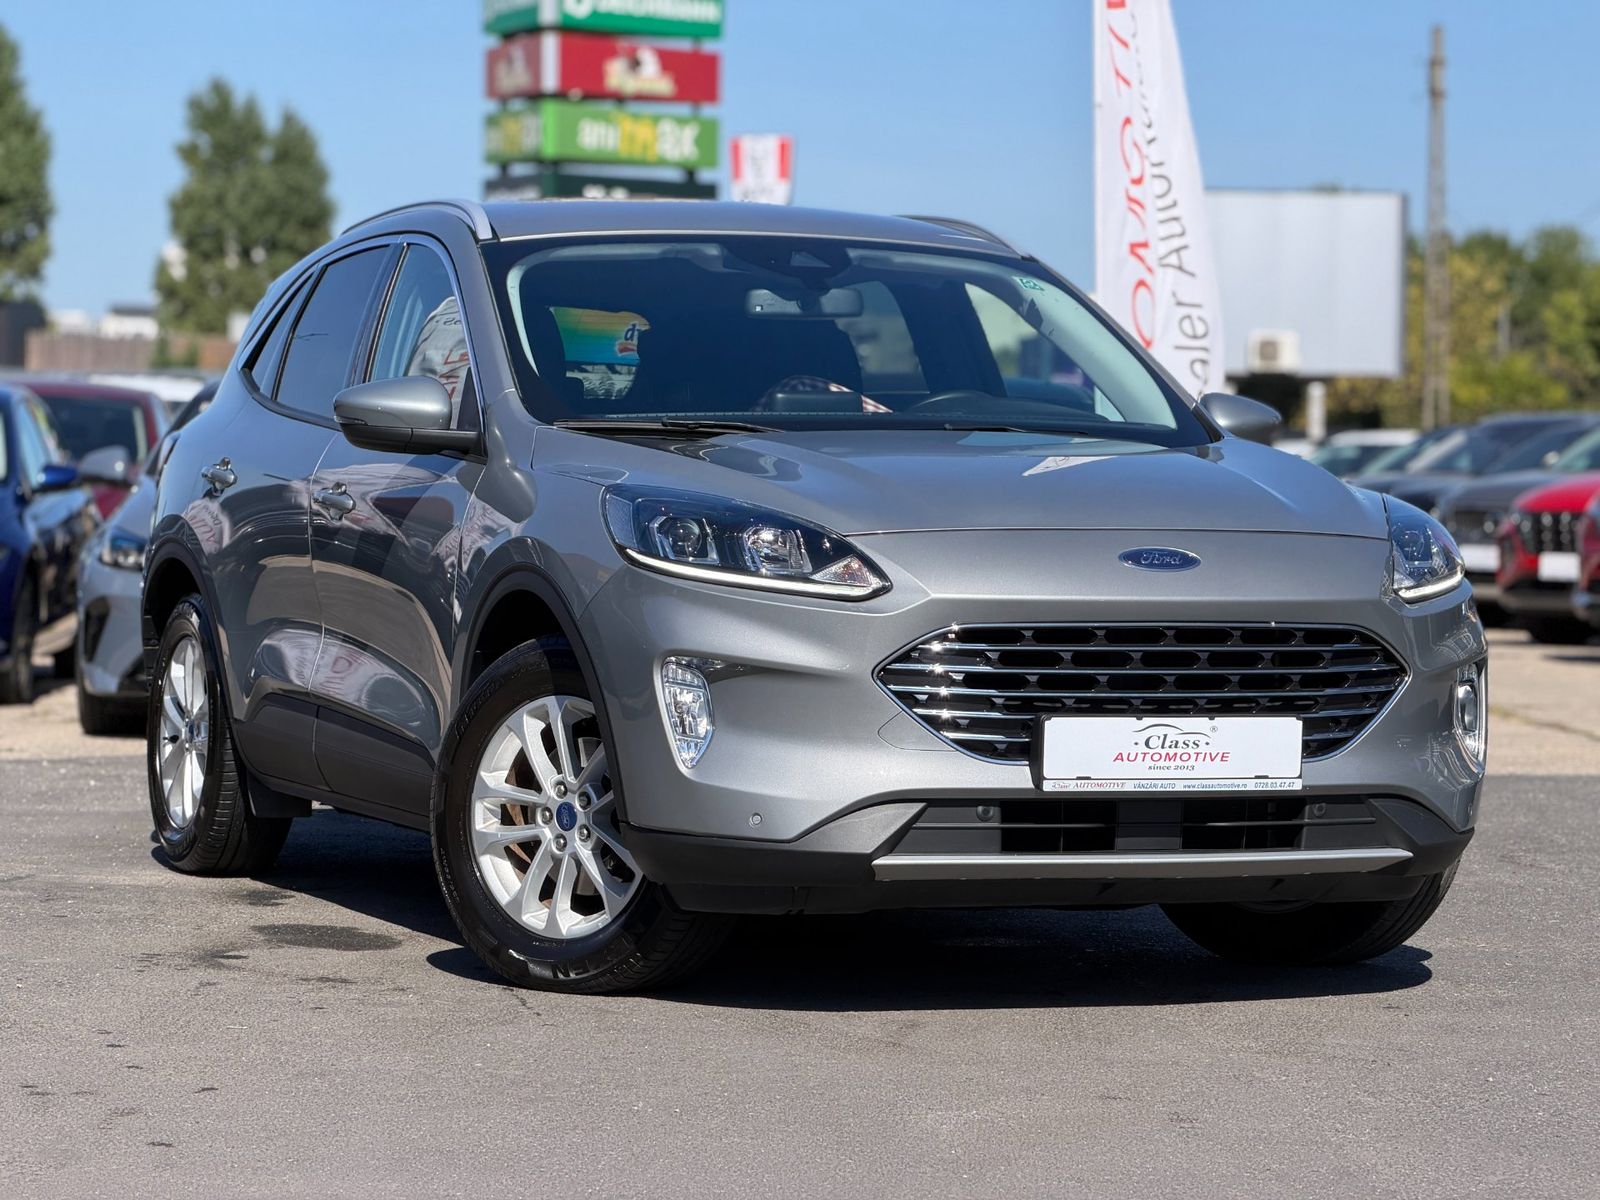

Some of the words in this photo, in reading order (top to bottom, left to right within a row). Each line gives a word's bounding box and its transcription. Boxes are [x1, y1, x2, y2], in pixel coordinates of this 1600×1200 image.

[1140, 551, 1182, 565] Ford
[1144, 733, 1201, 750] Class
[1113, 752, 1231, 762] AUTOMOTIVE
[1073, 781, 1126, 790] AUTOMOTIVE
[1159, 781, 1176, 790] AUTO
[1182, 782, 1248, 790] www.classautomotive.ro
[1254, 781, 1295, 790] 0728.03.47.47
